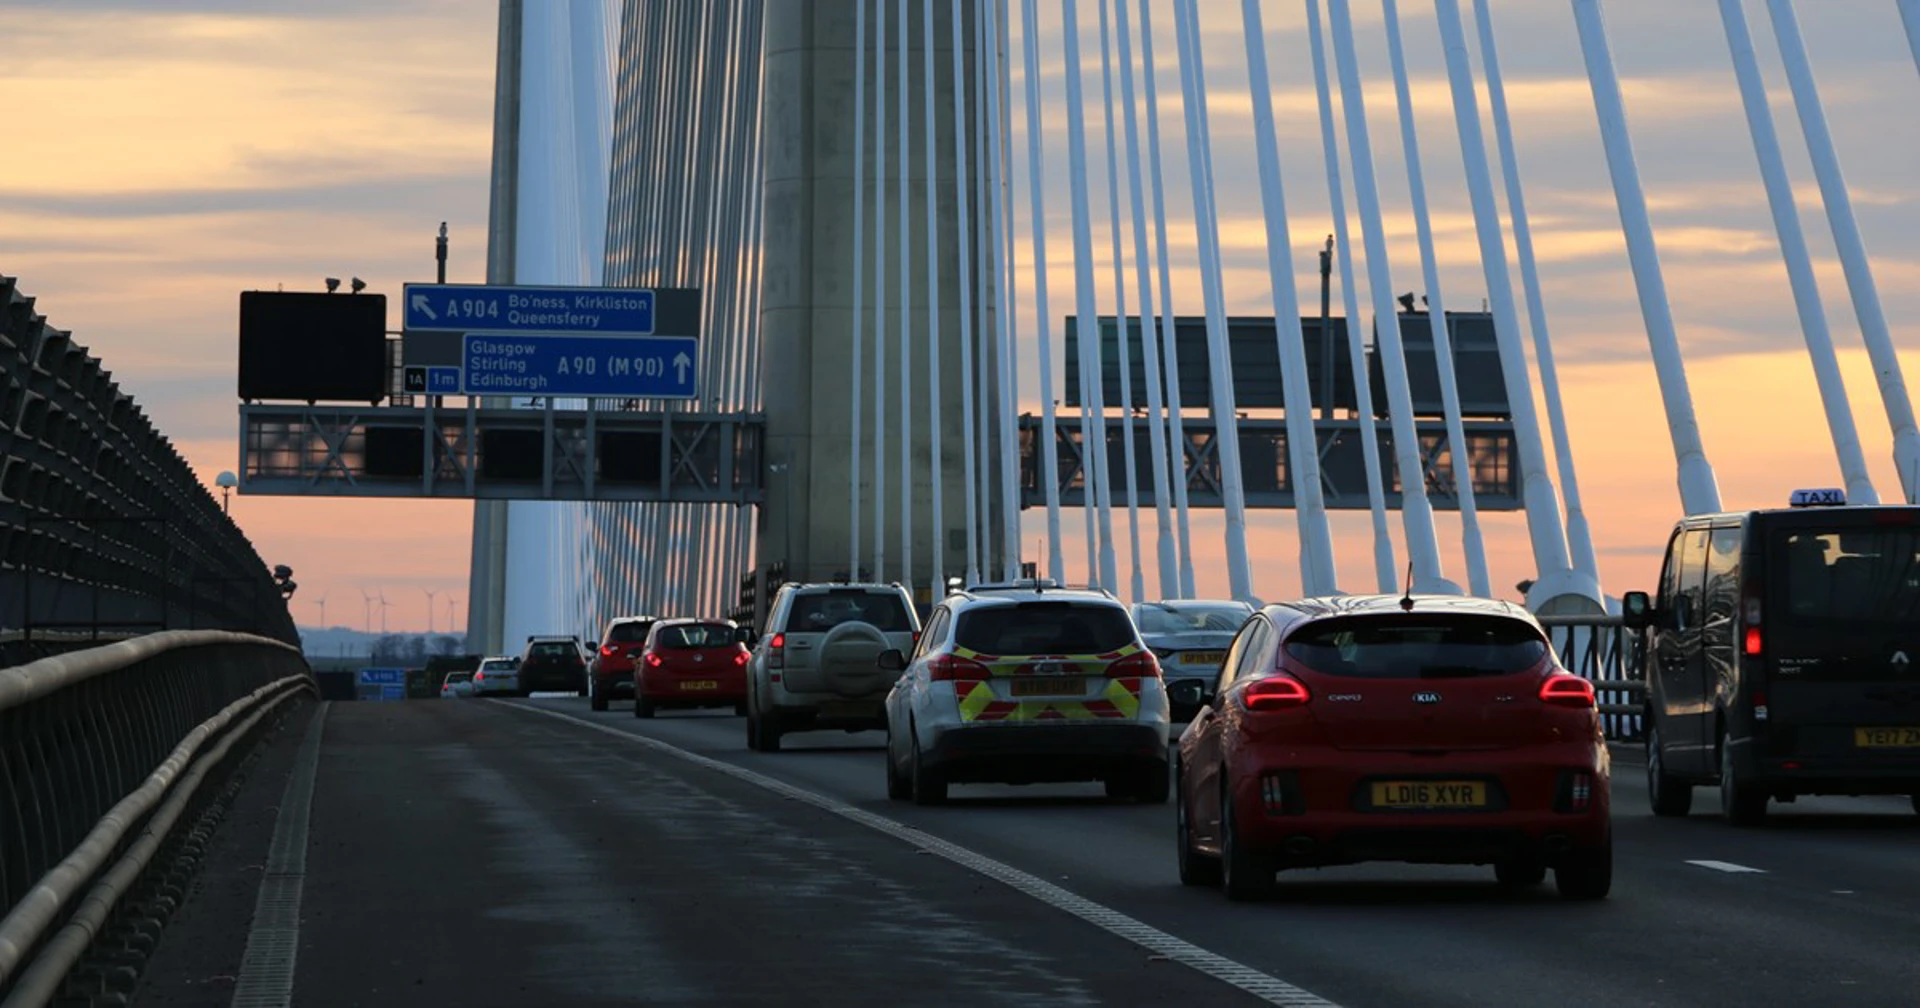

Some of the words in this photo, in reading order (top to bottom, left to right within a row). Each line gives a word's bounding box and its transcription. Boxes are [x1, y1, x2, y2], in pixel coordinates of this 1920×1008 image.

[575, 295, 648, 311] Kirkliston
[508, 310, 600, 328] Queensferry
[471, 340, 536, 357] Glasgow
[471, 356, 527, 372] Stirling
[409, 373, 423, 386] 1A
[471, 372, 548, 389] Edinburgh
[1798, 491, 1838, 503] TAXI
[1416, 692, 1438, 703] KIA
[1863, 728, 1899, 745] YE17
[1384, 784, 1430, 803] LD16
[1435, 784, 1473, 803] XYR
